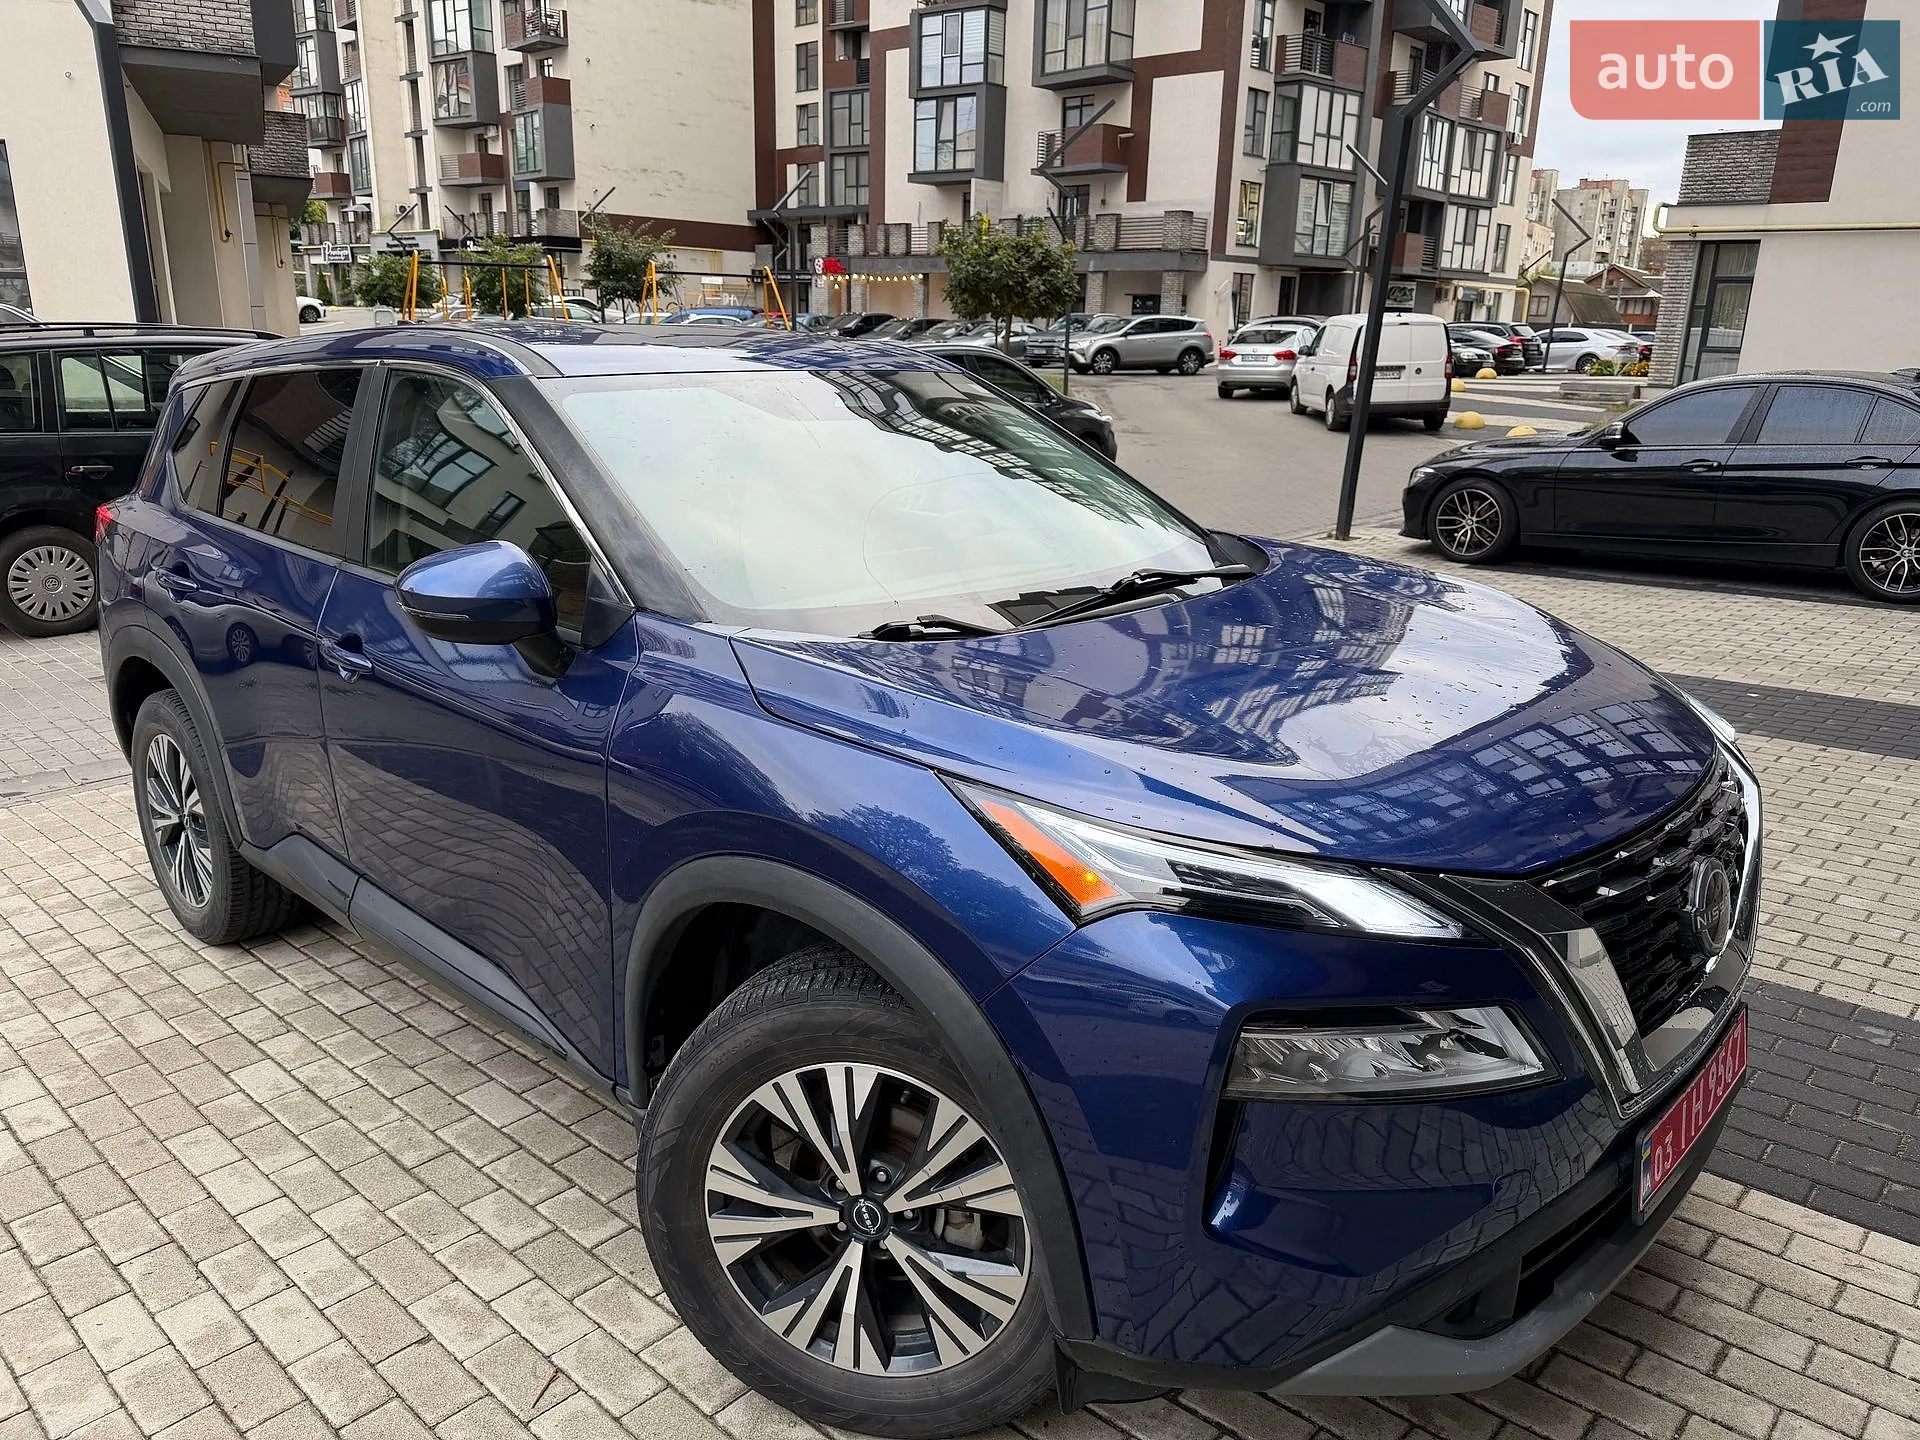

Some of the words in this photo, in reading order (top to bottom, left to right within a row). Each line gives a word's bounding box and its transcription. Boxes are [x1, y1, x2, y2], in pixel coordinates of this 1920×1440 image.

[1654, 1130, 1674, 1182] 03
[1681, 1079, 1705, 1149] IH
[1707, 1022, 1742, 1113] 9567
[858, 1199, 876, 1234] NISSAN
